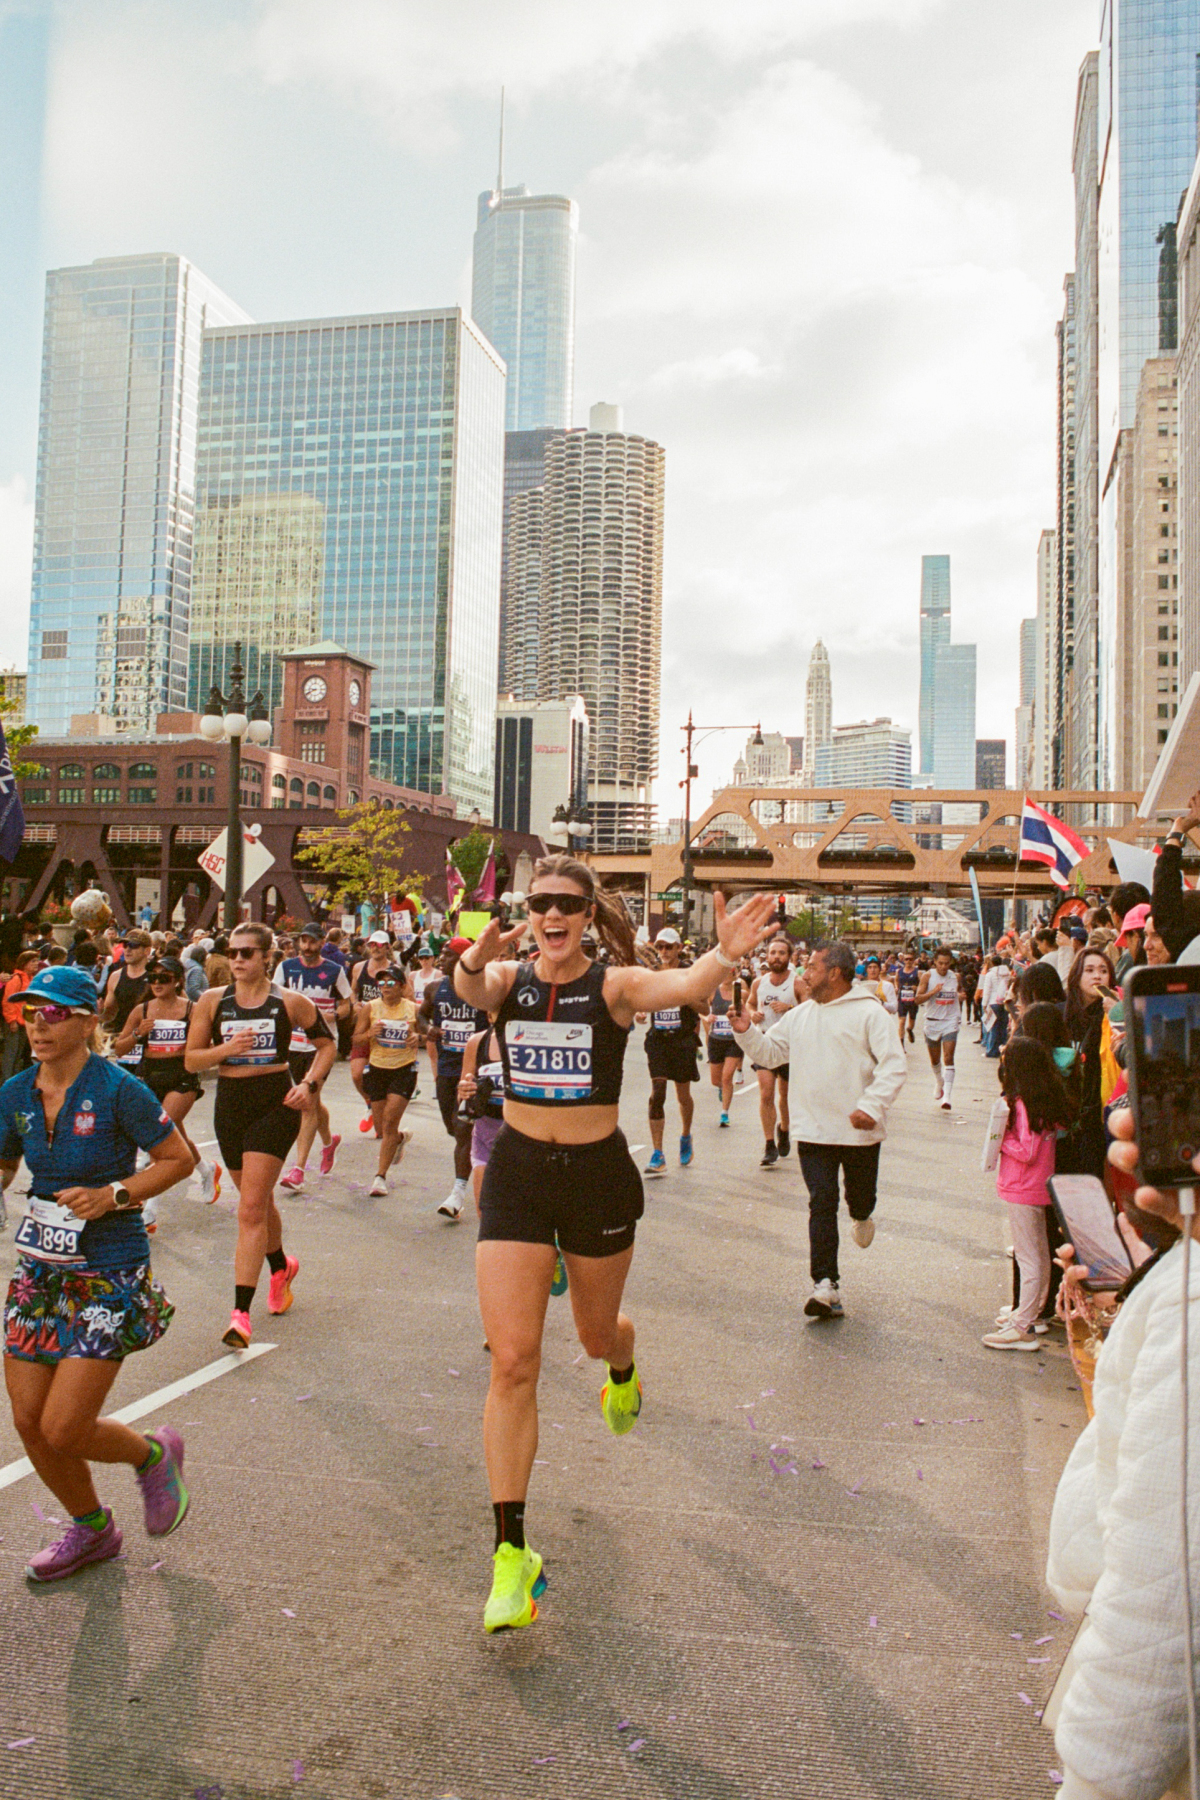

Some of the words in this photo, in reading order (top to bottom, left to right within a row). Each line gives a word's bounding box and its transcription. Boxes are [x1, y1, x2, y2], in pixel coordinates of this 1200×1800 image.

[201, 851, 226, 875] HSC
[660, 1011, 680, 1020] 10781
[155, 1029, 186, 1040] 30728
[385, 1029, 408, 1039] 6276
[509, 1047, 520, 1068] E
[525, 1048, 591, 1071] 21810
[17, 1218, 35, 1243] E
